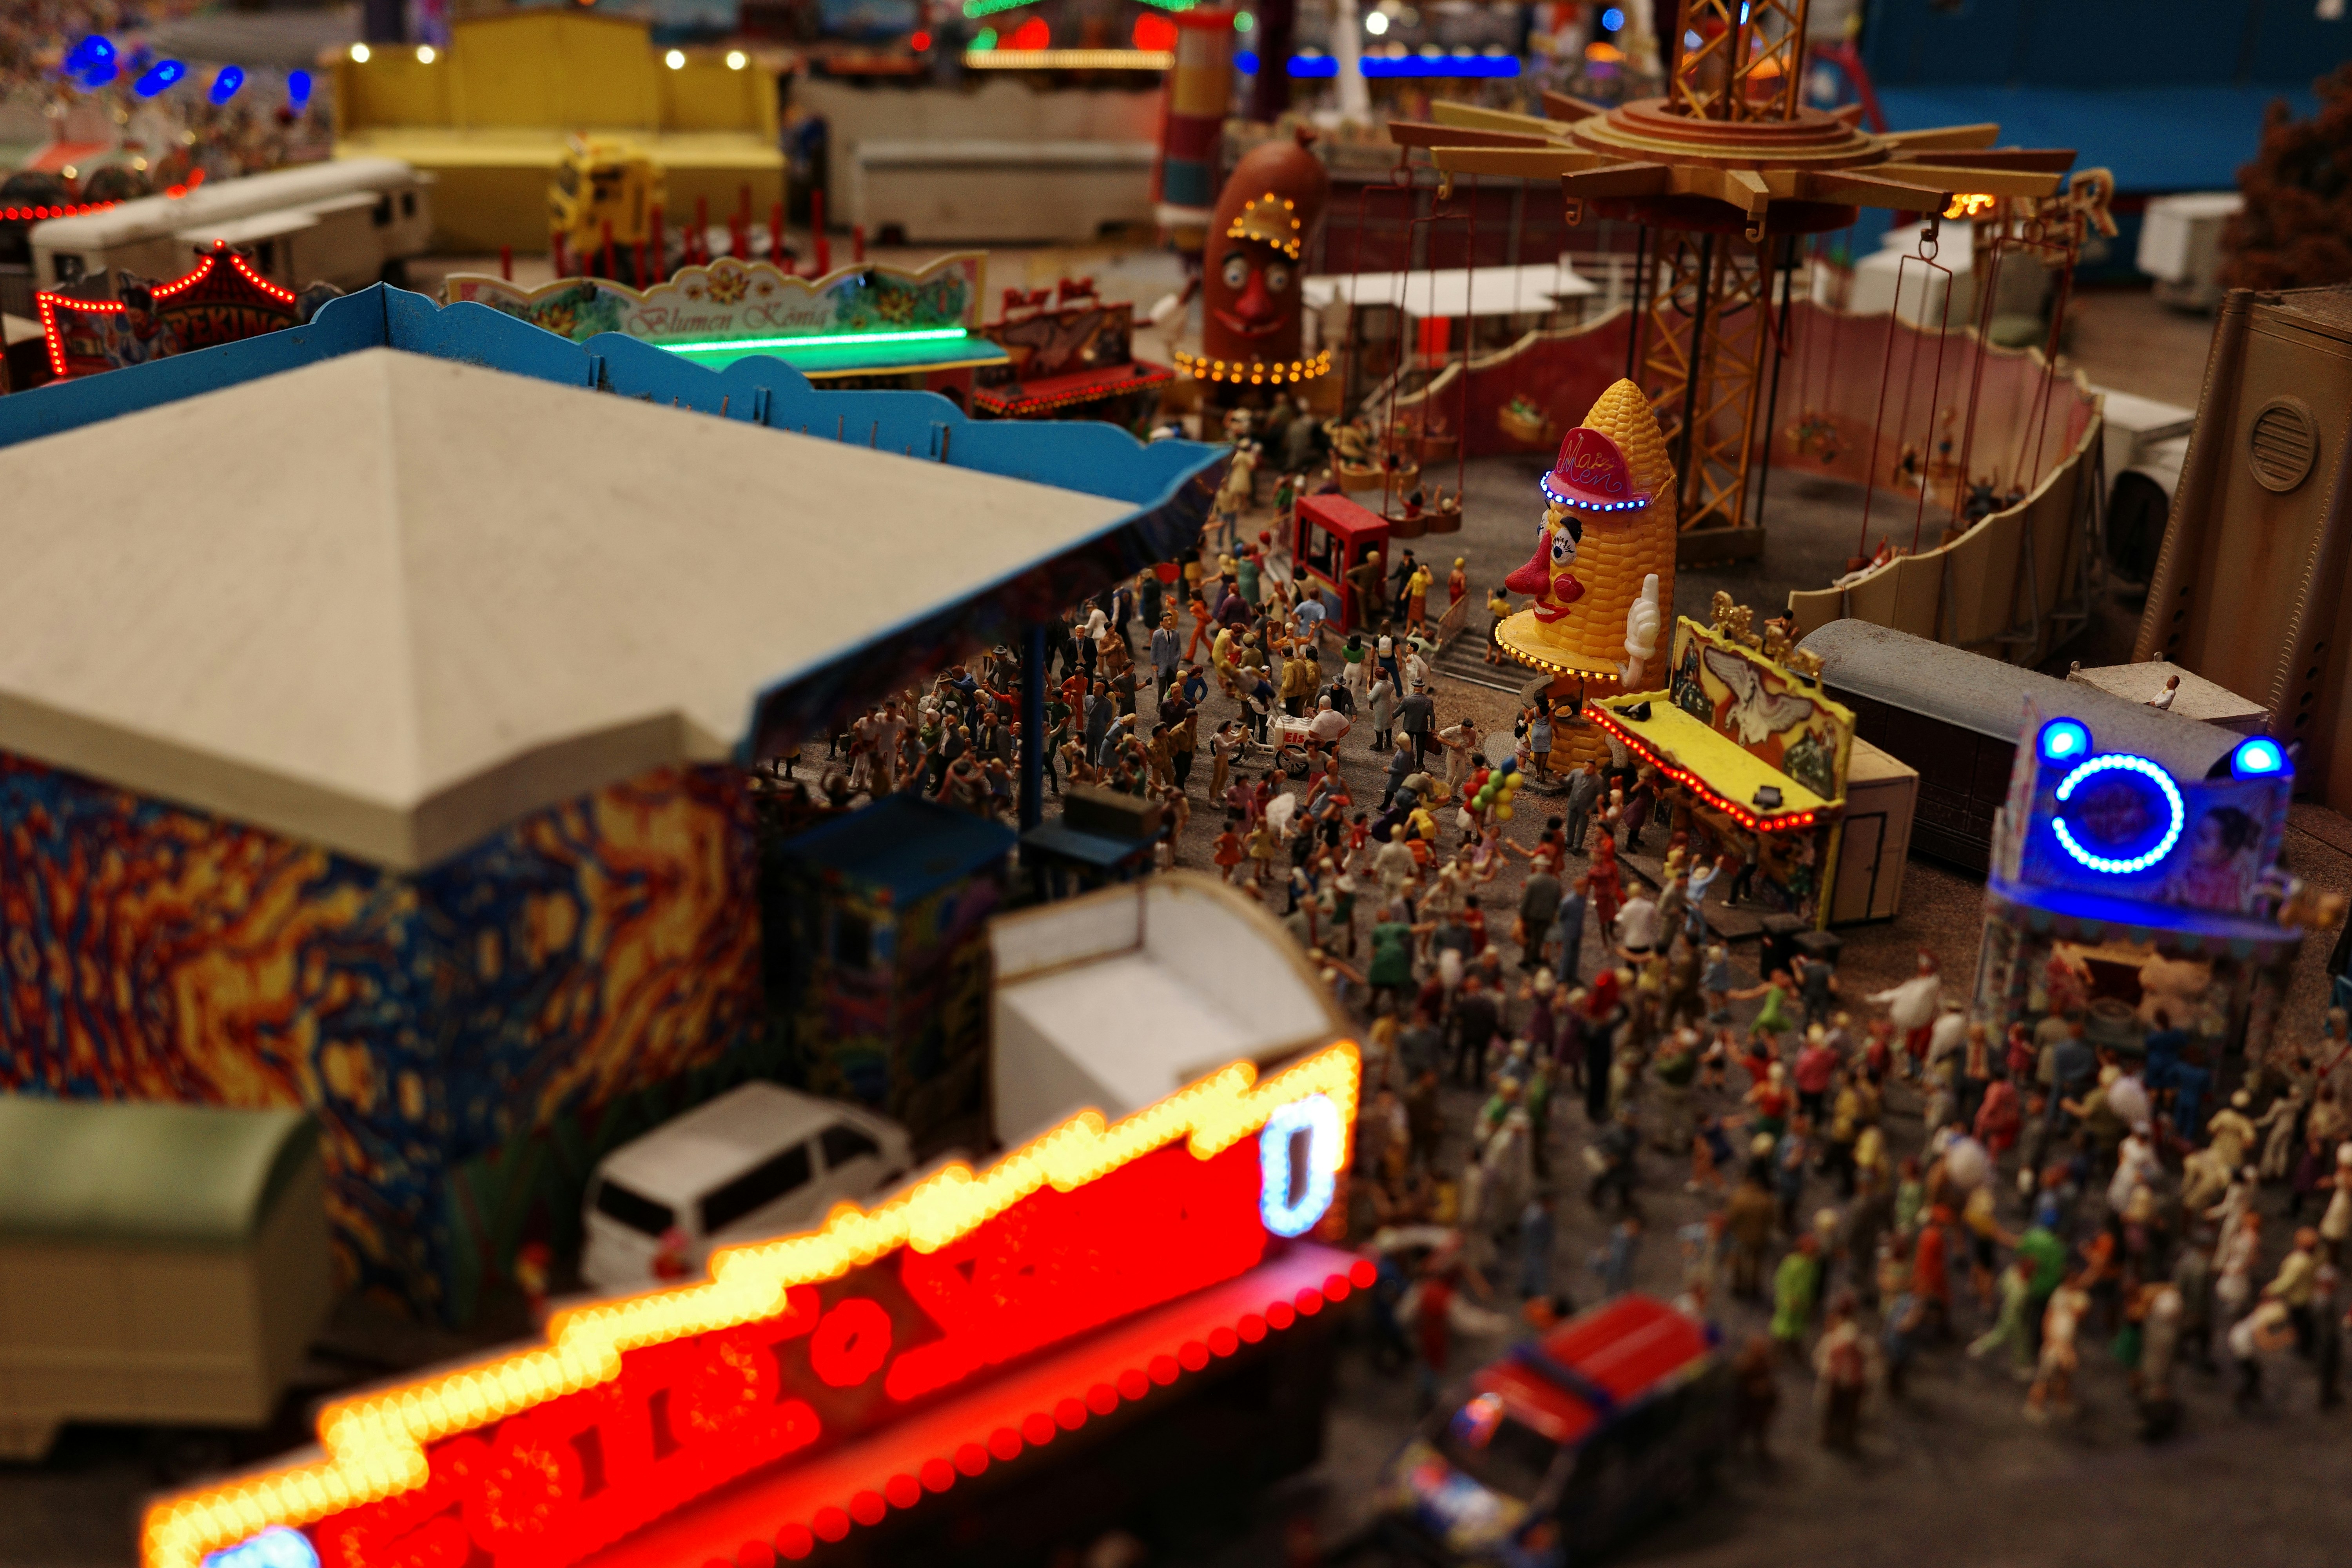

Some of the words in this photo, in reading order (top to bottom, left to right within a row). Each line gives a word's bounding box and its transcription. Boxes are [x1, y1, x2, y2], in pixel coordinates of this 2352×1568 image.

[628, 307, 734, 336] Blumen
[1559, 457, 1622, 492] Men
[1284, 732, 1305, 743] Eis
